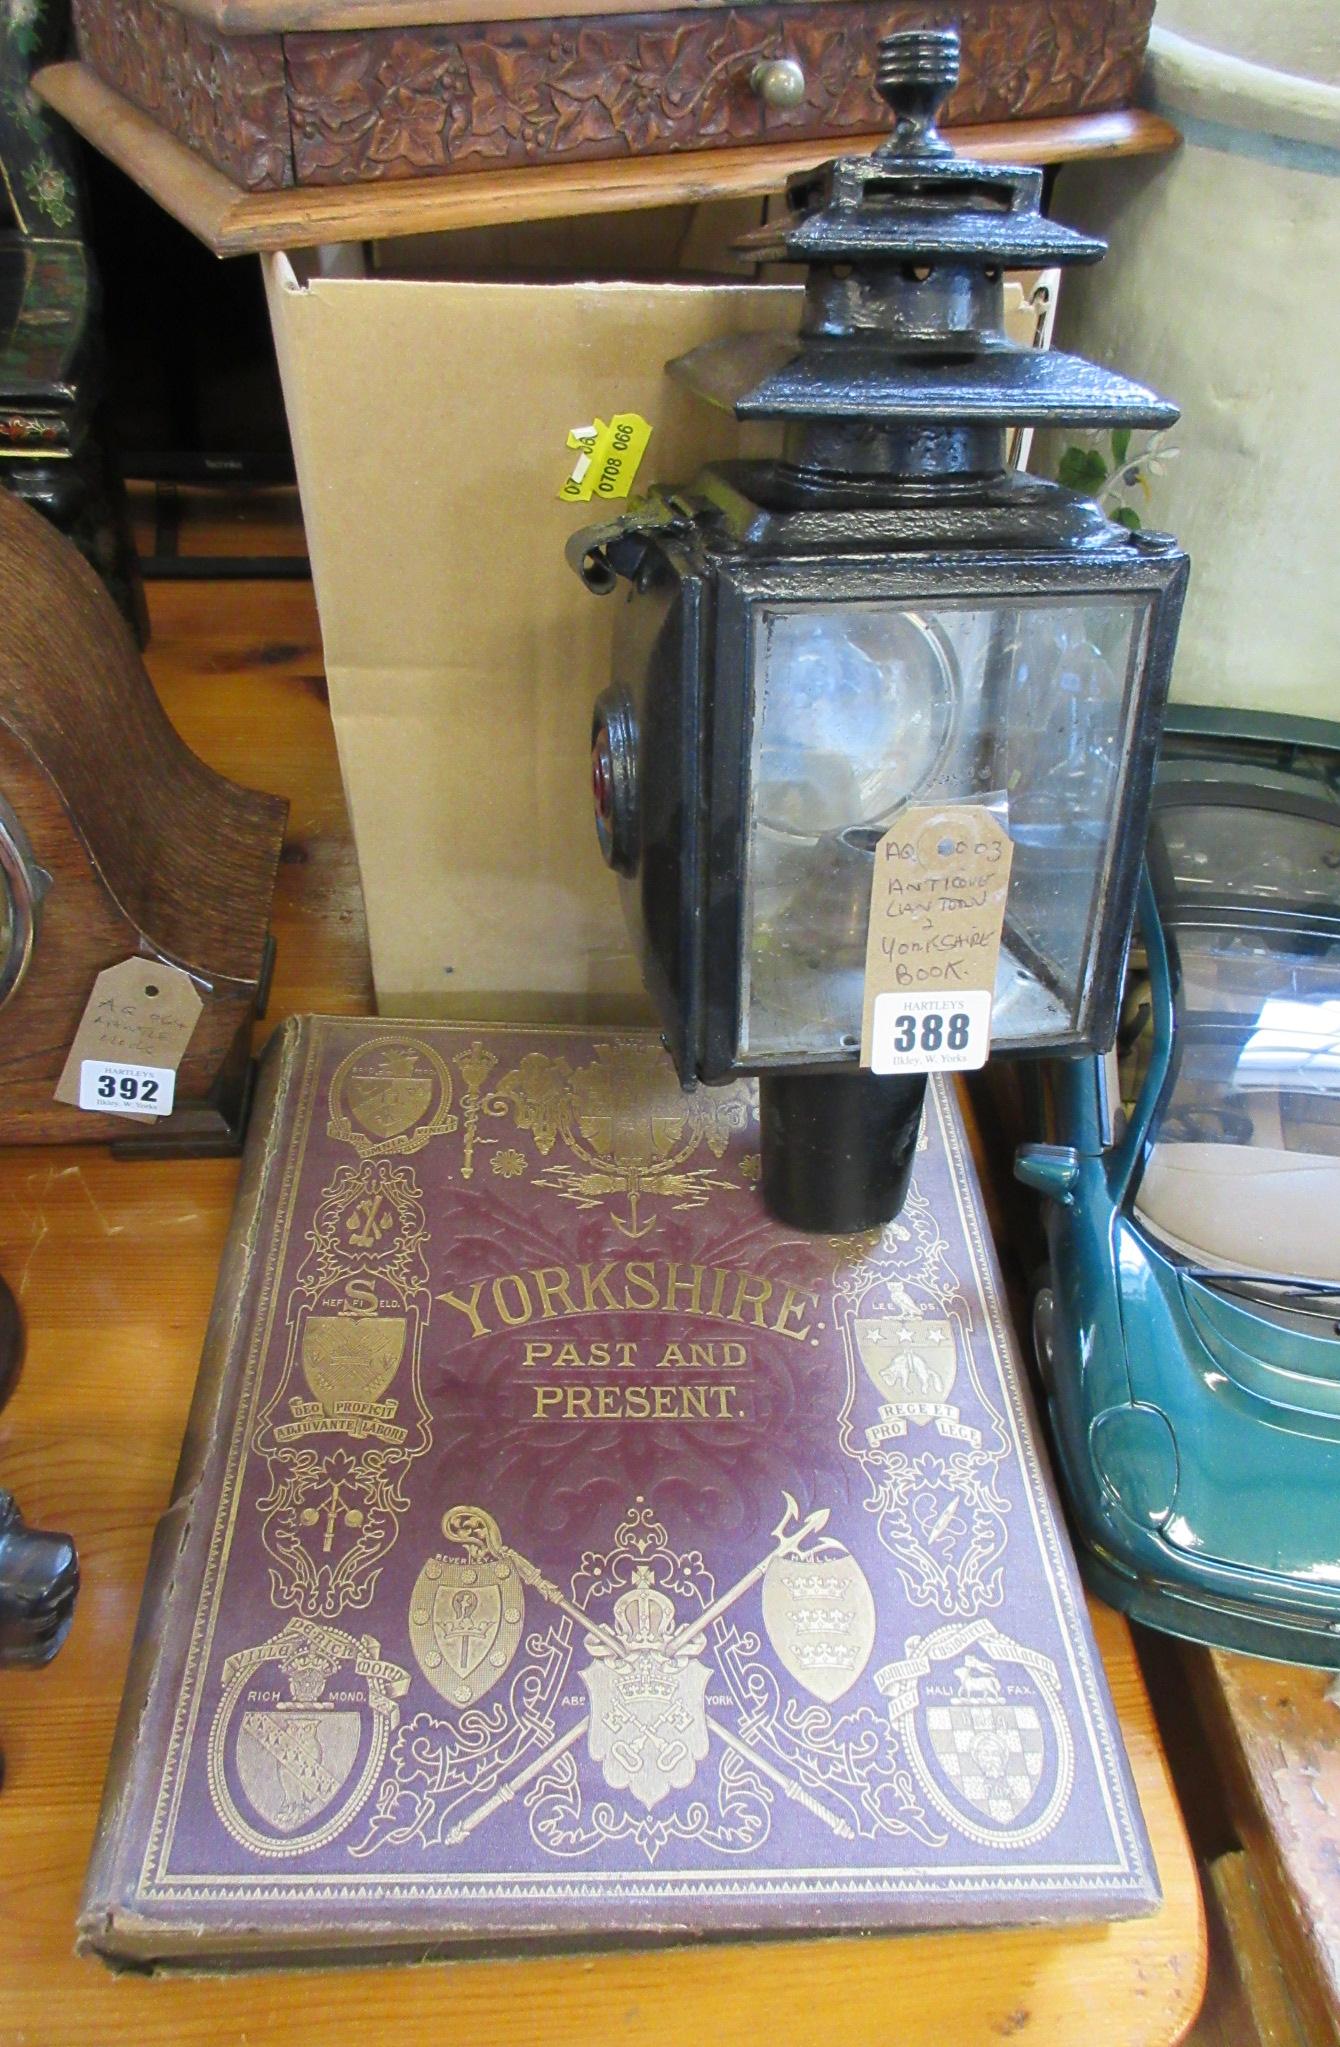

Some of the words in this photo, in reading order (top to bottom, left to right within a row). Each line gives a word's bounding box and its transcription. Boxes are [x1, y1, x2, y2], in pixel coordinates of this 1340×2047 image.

[598, 458, 623, 492] 0708
[612, 424, 633, 451] 066
[903, 1000, 965, 1011] HARTLEYS
[894, 1013, 970, 1053] 388
[941, 1054, 968, 1063] Yorks
[104, 1067, 155, 1079] HARTLEYS
[98, 1075, 159, 1103] 392
[522, 1342, 638, 1368] PAST
[656, 1342, 747, 1368] AND
[294, 1404, 320, 1416] DEO
[336, 1402, 395, 1418] PROFICIT
[532, 1386, 746, 1419] PRESENT.
[884, 1404, 928, 1417] REGE
[935, 1404, 953, 1417] ET
[276, 1419, 355, 1438] ADJUVANTE
[362, 1421, 407, 1440] LABORE
[871, 1422, 902, 1440] PRO
[940, 1422, 979, 1440] LEGE
[247, 1691, 281, 1701] RICH
[328, 1691, 367, 1702] MOND.
[704, 1695, 733, 1706] YORK
